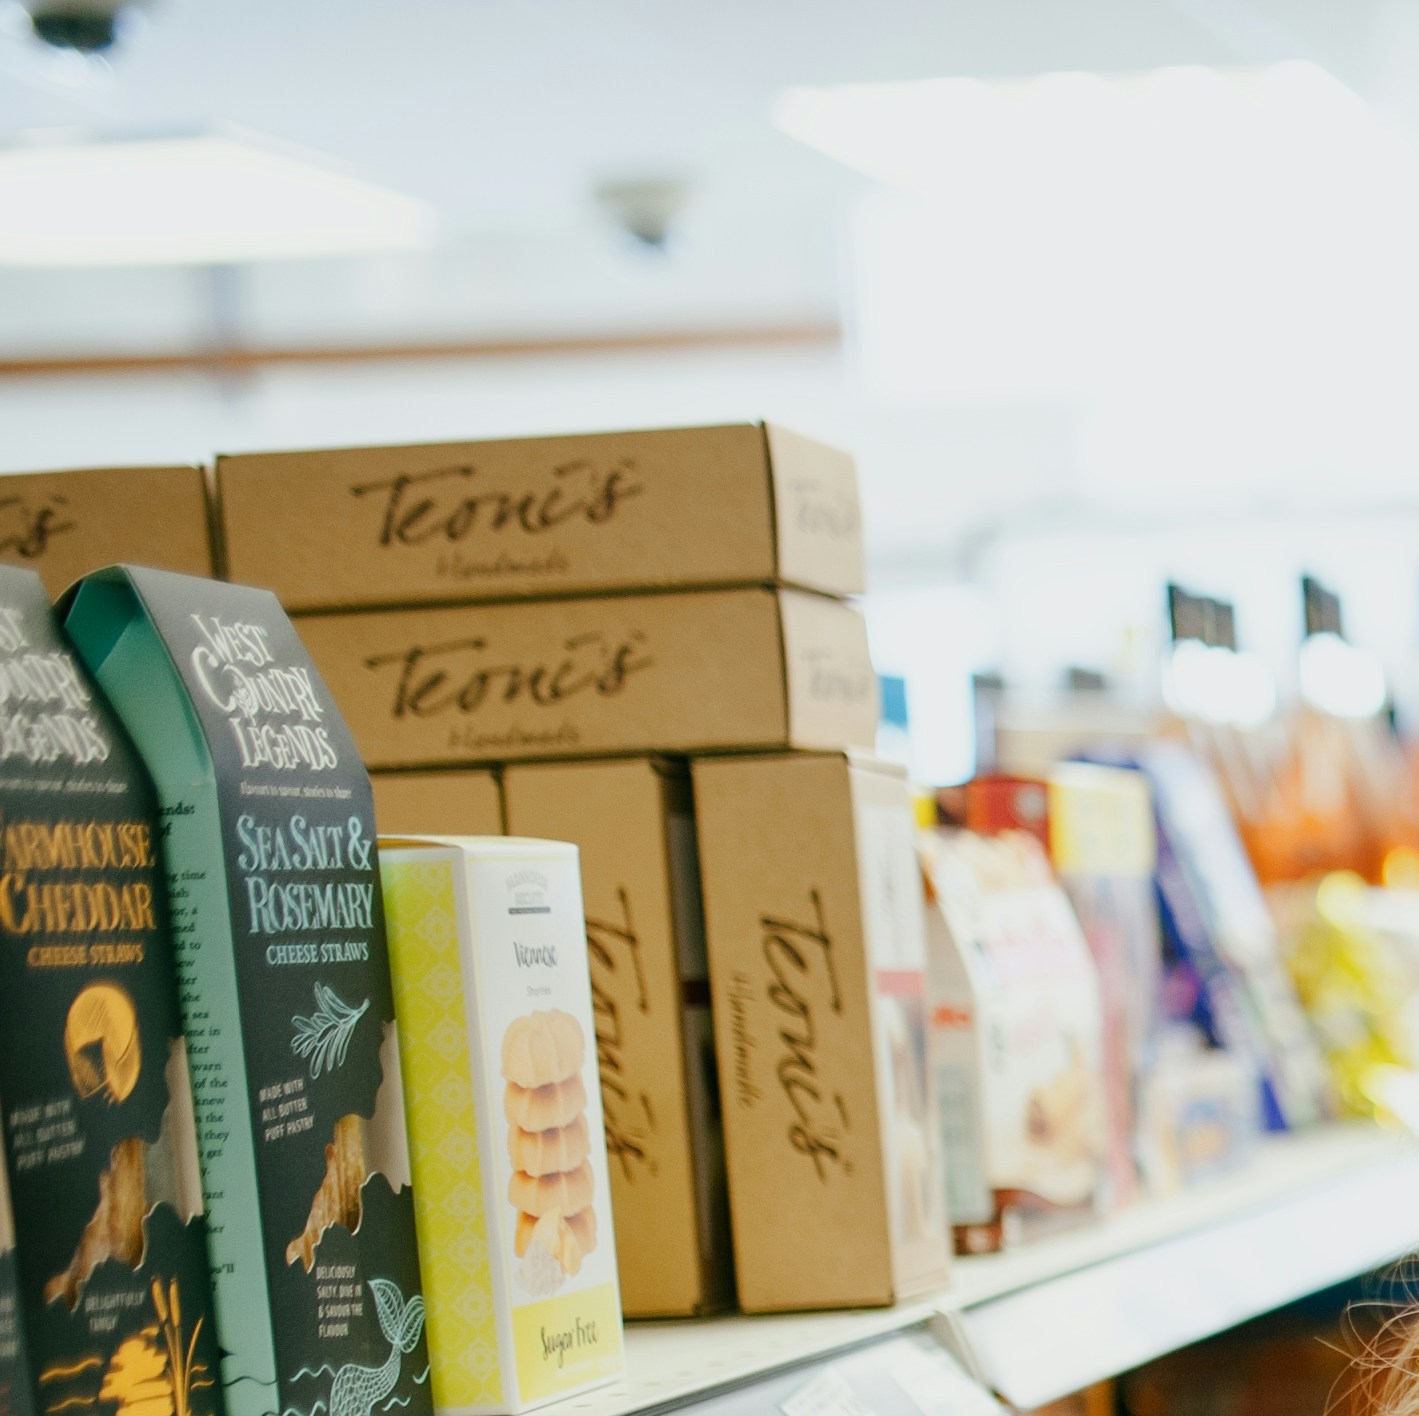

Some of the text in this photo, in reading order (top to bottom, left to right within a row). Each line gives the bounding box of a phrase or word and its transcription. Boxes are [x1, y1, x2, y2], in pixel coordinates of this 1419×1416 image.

[190, 614, 275, 667] WEST
[191, 647, 324, 722] COUNTRY
[229, 717, 338, 771] LEGENDS
[237, 815, 372, 872] SEA SALT &
[0, 869, 155, 933] CHEDDAR
[245, 876, 373, 933] ROSEMARY
[27, 943, 144, 967] CHEESE STRAWS
[266, 942, 369, 965] CHEESE STRAWS
[540, 1317, 598, 1369] Sugar Free
